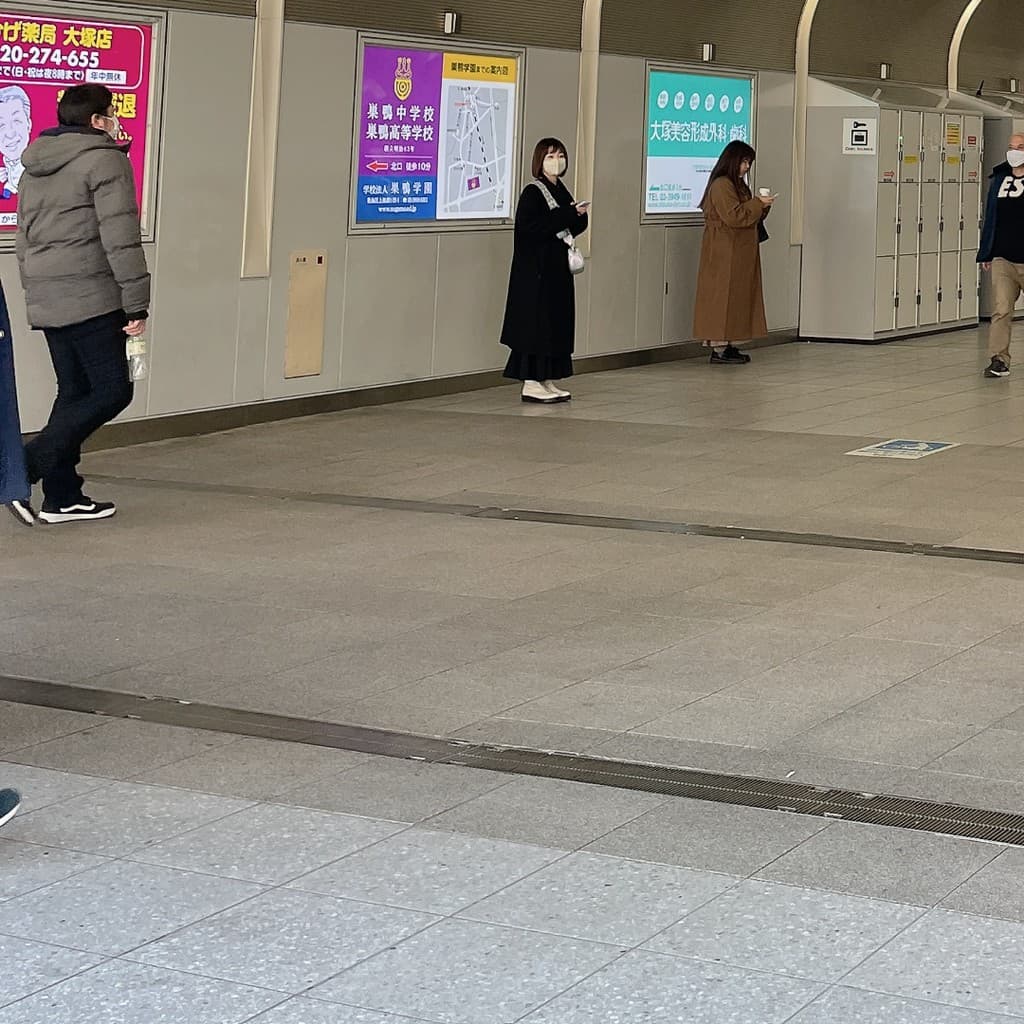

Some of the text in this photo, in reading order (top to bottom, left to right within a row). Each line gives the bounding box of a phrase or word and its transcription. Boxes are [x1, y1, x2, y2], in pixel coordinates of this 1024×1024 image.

[63, 26, 113, 49] 大塚店
[367, 102, 435, 122] 巣鴨中学校
[366, 123, 434, 141] 巣鴨高等学校
